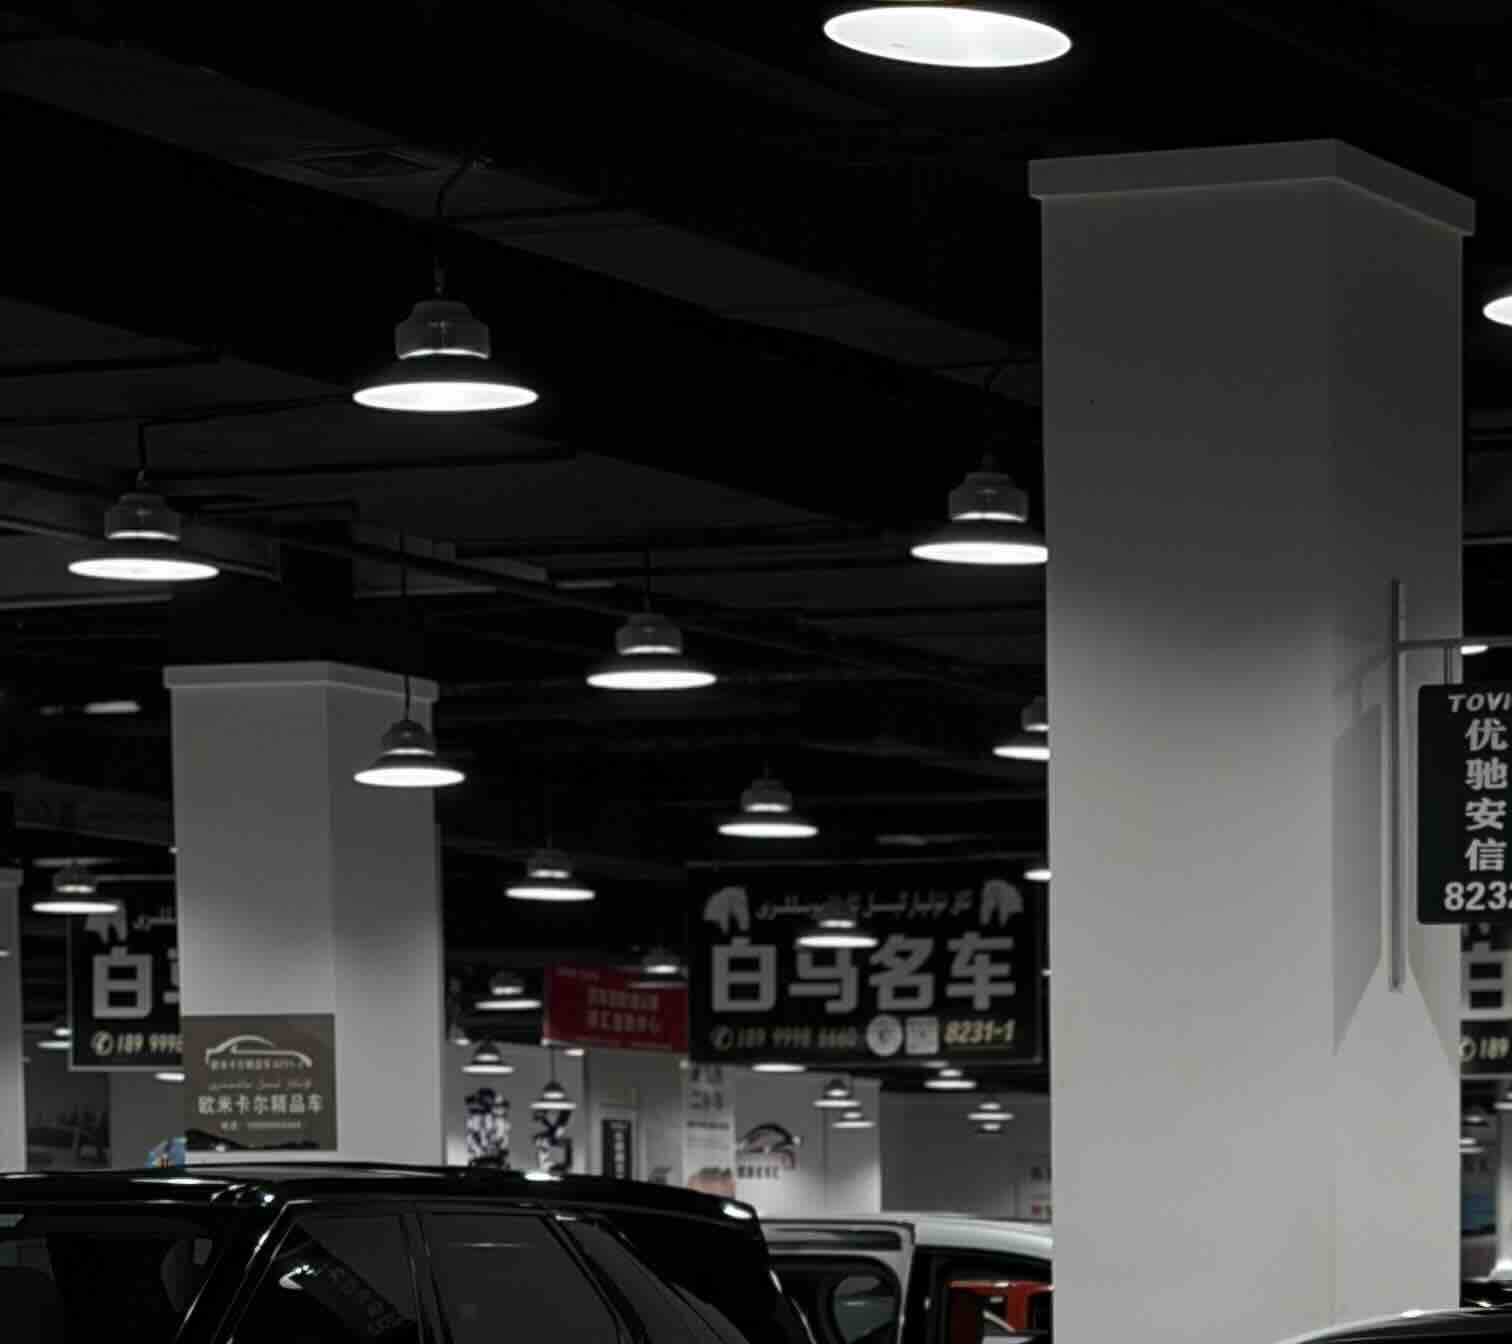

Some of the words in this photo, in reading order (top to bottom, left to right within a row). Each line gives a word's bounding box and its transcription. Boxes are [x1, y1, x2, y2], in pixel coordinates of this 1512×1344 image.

[1464, 718, 1509, 873] 优驰安信
[711, 932, 1016, 1014] 白马名车
[943, 1019, 1016, 1044] 8231-1
